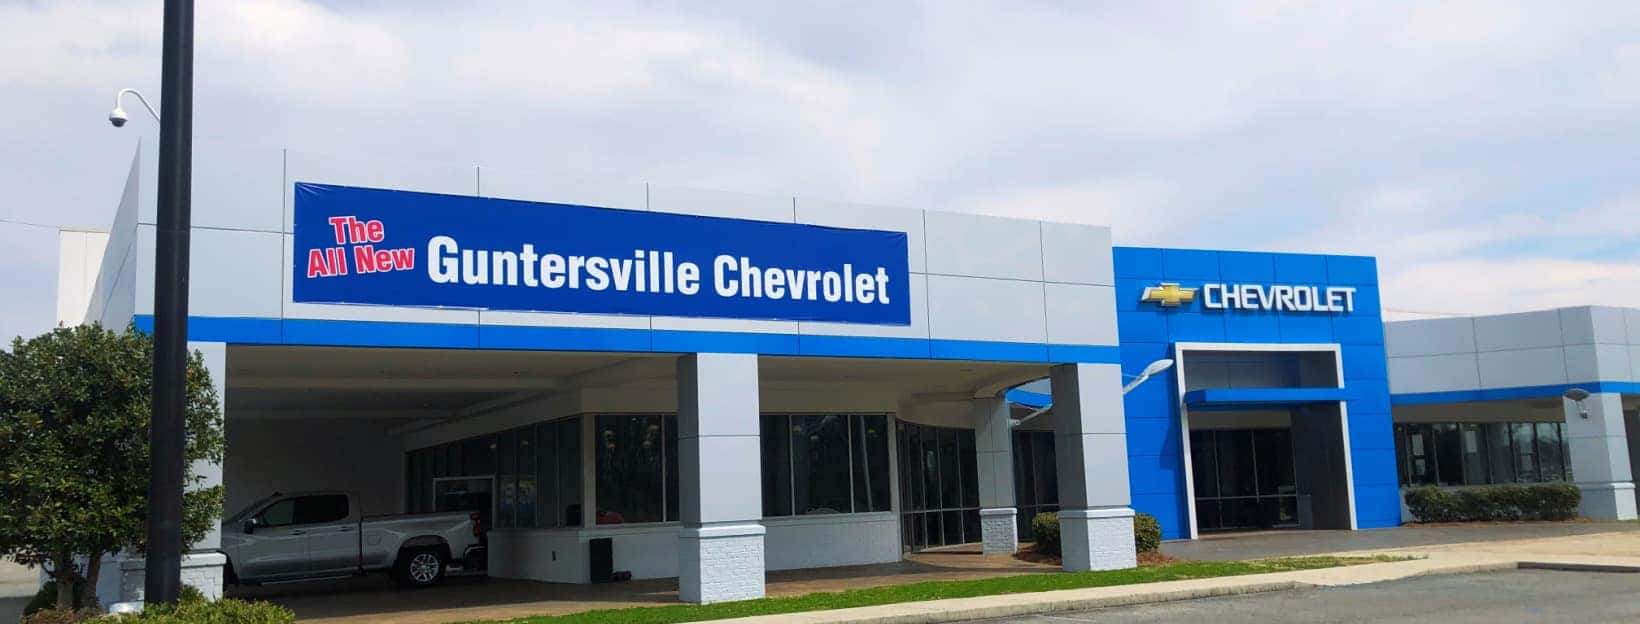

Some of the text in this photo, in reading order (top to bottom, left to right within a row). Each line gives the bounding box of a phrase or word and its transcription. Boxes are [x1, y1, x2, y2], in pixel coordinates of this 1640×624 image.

[329, 216, 384, 244] The
[307, 245, 415, 278] All New
[427, 235, 890, 304] Guntersville Chevrolet
[1203, 283, 1356, 312] CHEVROLET
